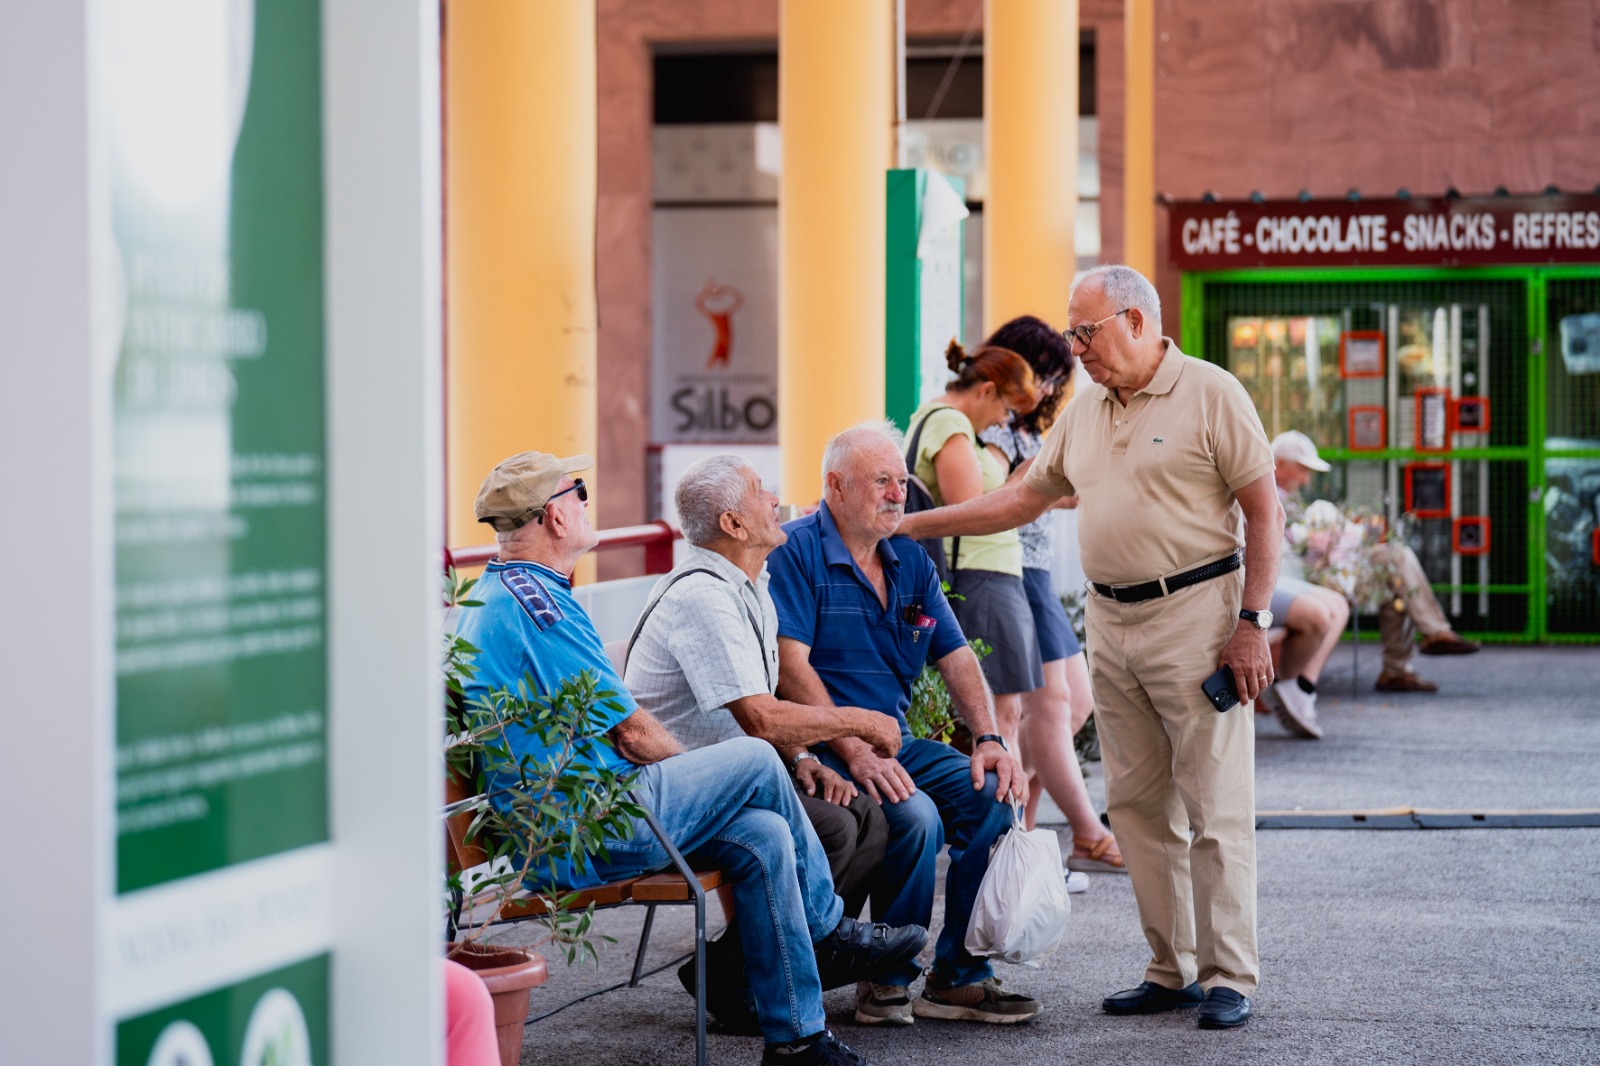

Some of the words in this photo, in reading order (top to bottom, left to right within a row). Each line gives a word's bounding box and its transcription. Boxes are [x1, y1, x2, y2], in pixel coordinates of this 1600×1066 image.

[1182, 209, 1241, 255] CAFÉ
[1255, 215, 1388, 254] CHOCOLATE
[1403, 212, 1497, 252] SNACKS
[1513, 211, 1600, 250] REFRES
